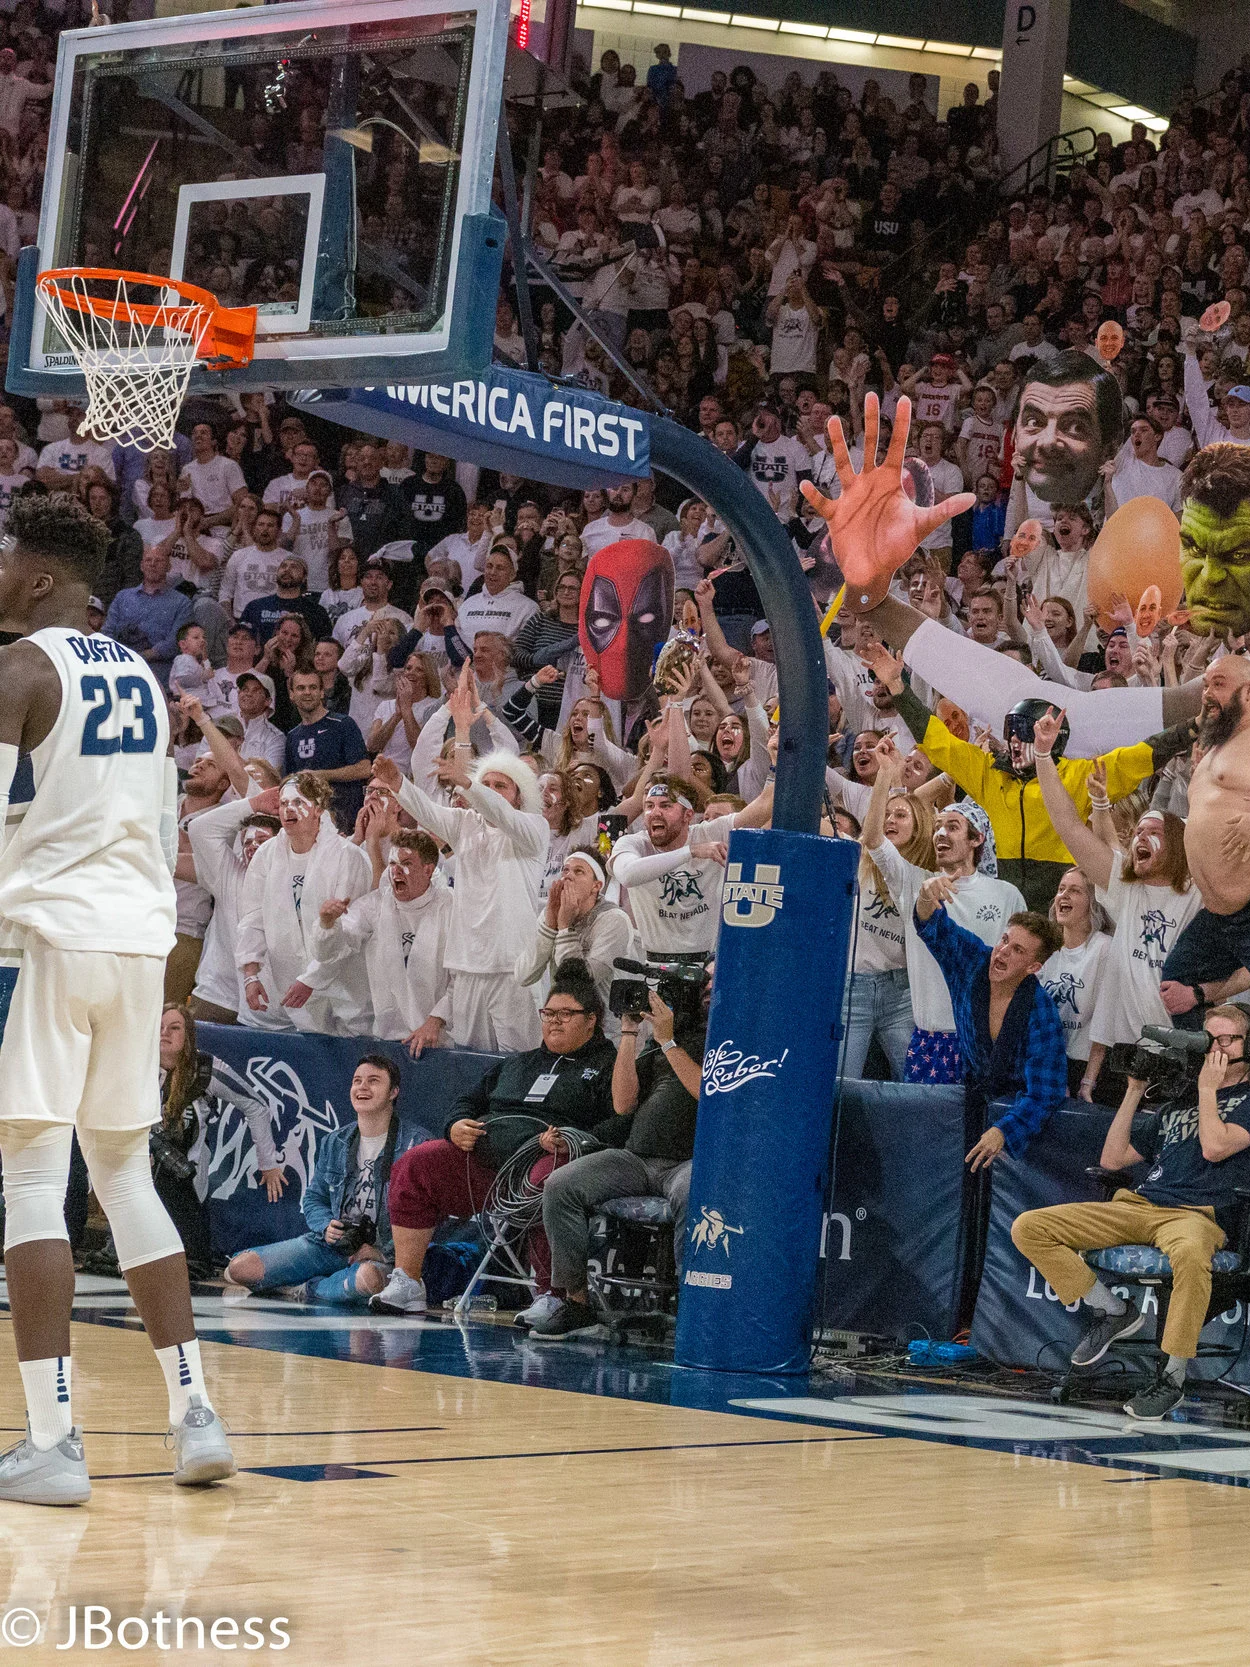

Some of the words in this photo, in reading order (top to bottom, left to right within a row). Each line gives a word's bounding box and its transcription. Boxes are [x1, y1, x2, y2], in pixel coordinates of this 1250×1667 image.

[1017, 6, 1036, 32] D
[874, 220, 899, 235] USU
[926, 403, 940, 416] 16
[543, 401, 643, 461] FIRST
[752, 462, 789, 474] STATE
[411, 503, 446, 514] STATE
[80, 675, 158, 756] 23
[680, 903, 710, 920] NEVADA
[684, 1271, 732, 1290] AGGIES
